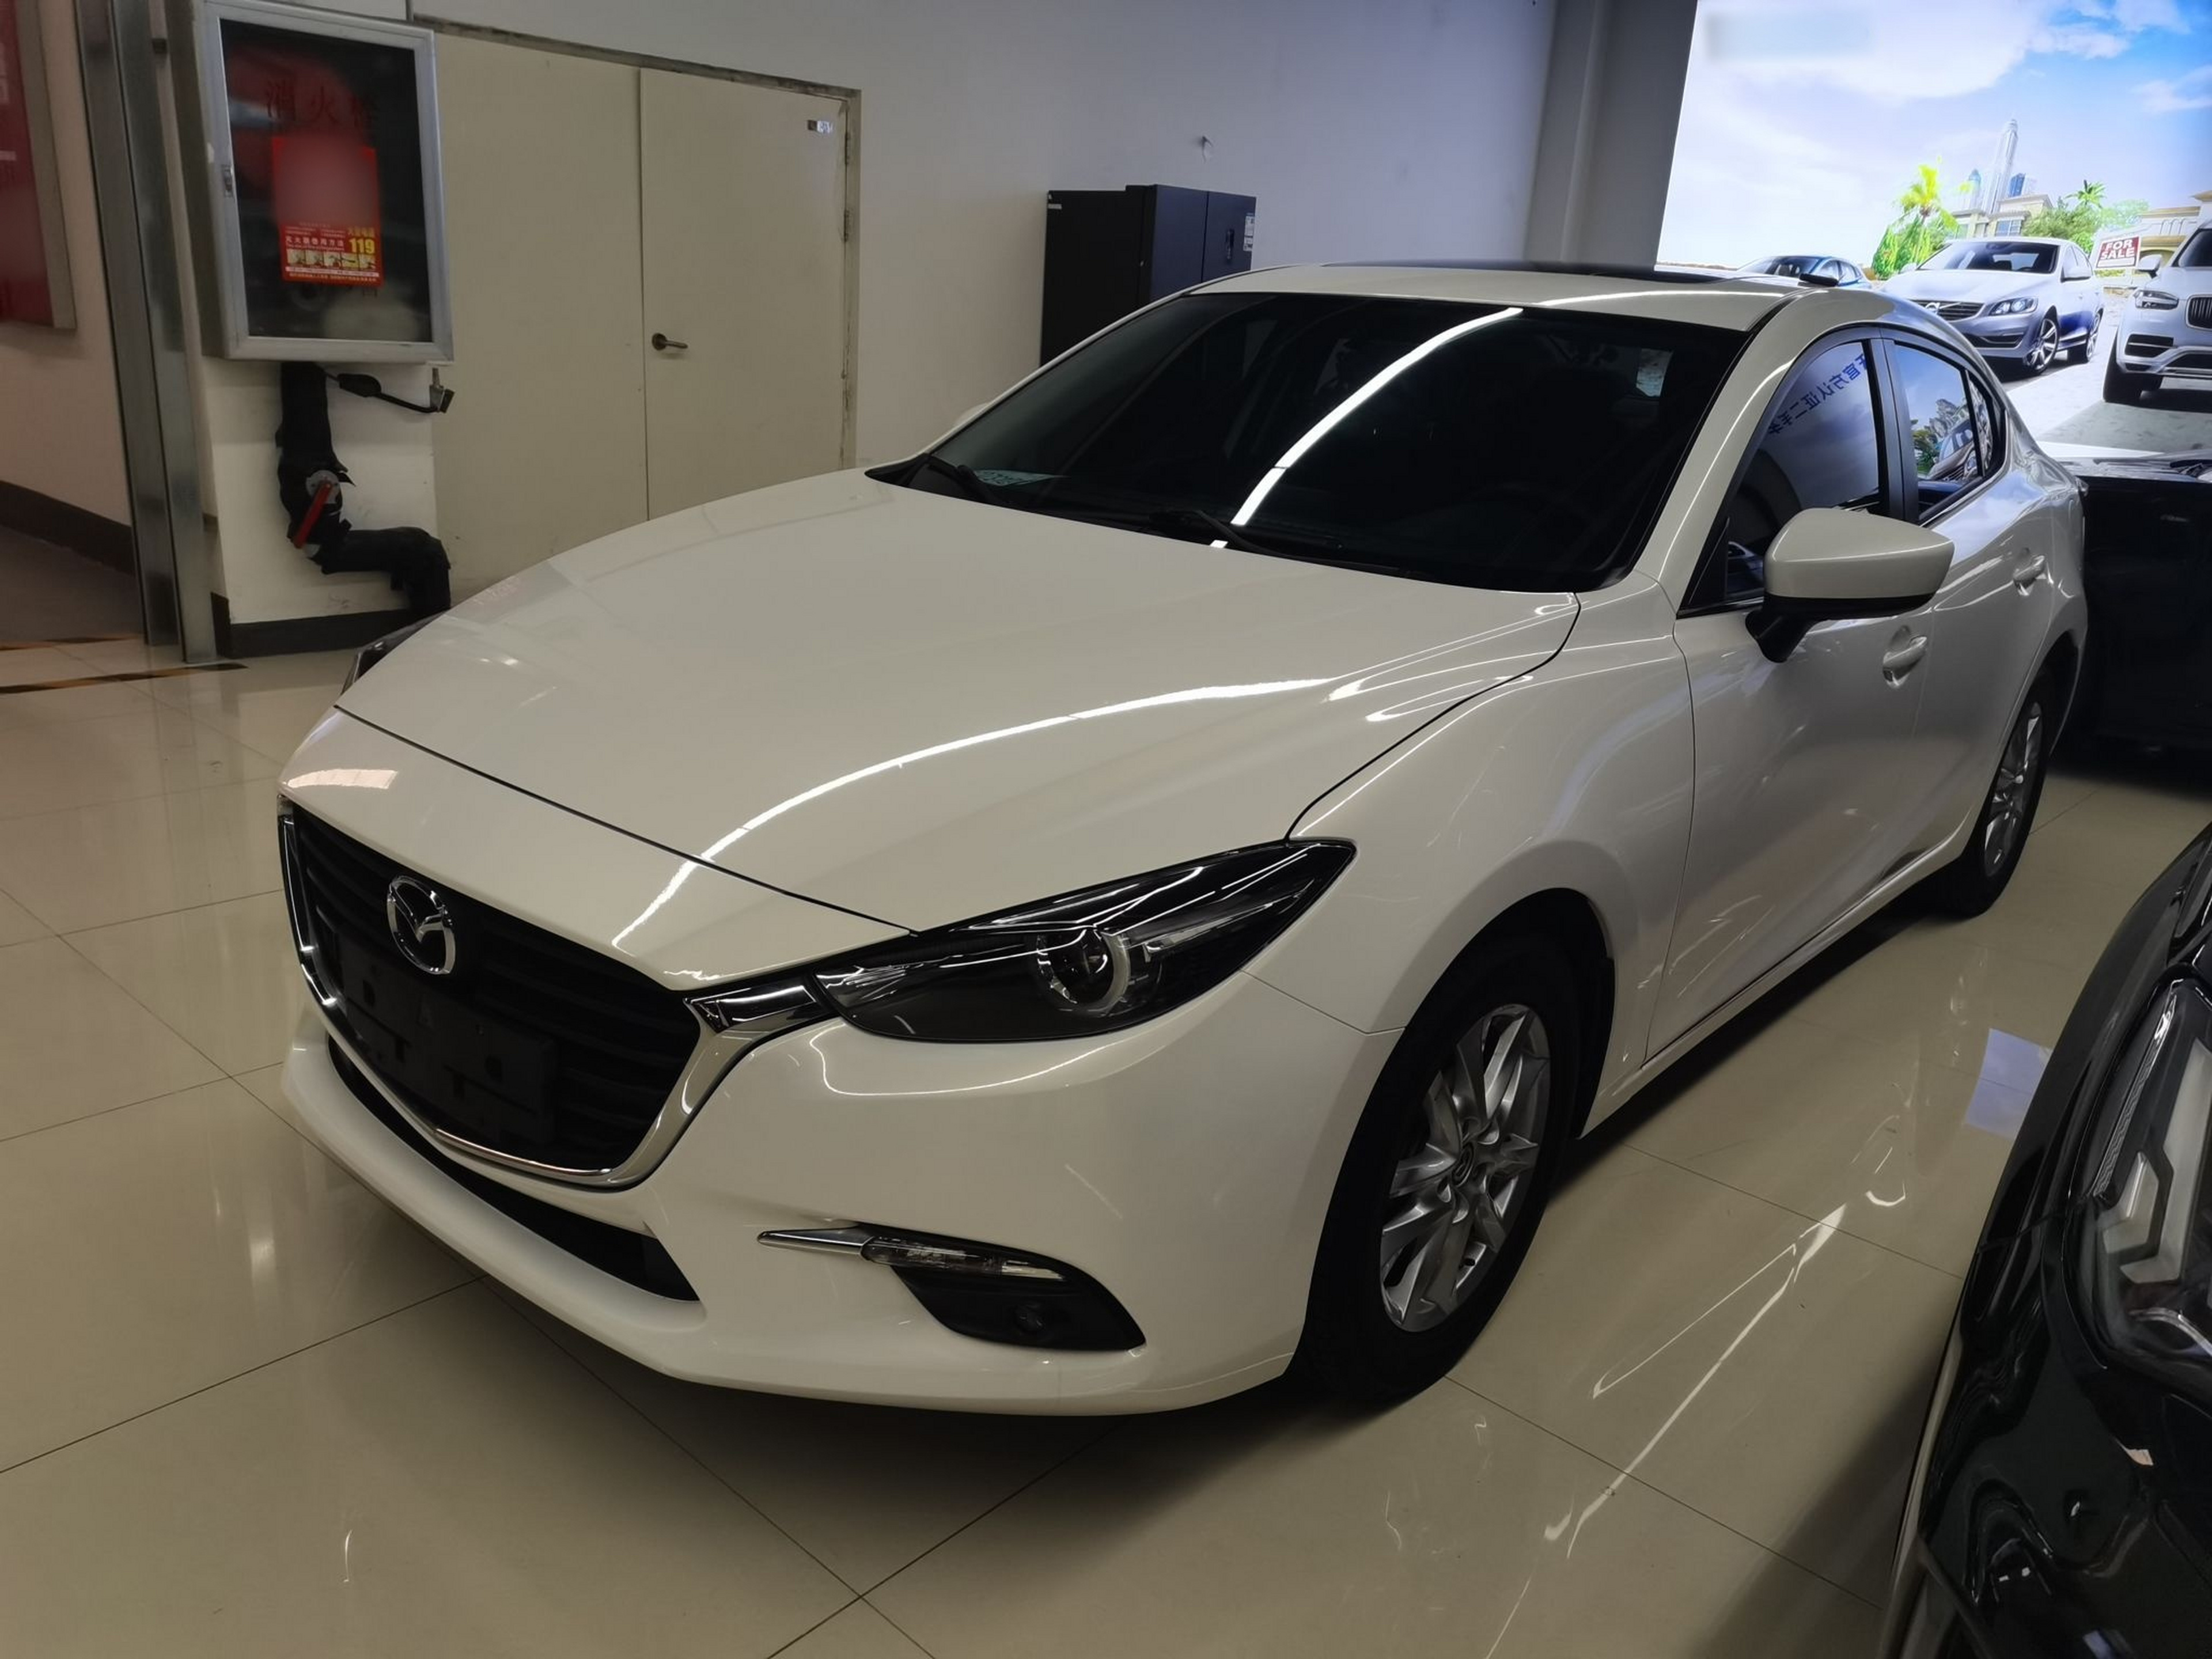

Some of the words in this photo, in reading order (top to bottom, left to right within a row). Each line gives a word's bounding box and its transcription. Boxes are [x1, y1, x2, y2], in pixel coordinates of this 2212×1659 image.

[349, 238, 375, 254] 119
[2105, 239, 2133, 251] FOR
[2100, 247, 2135, 259] SALE
